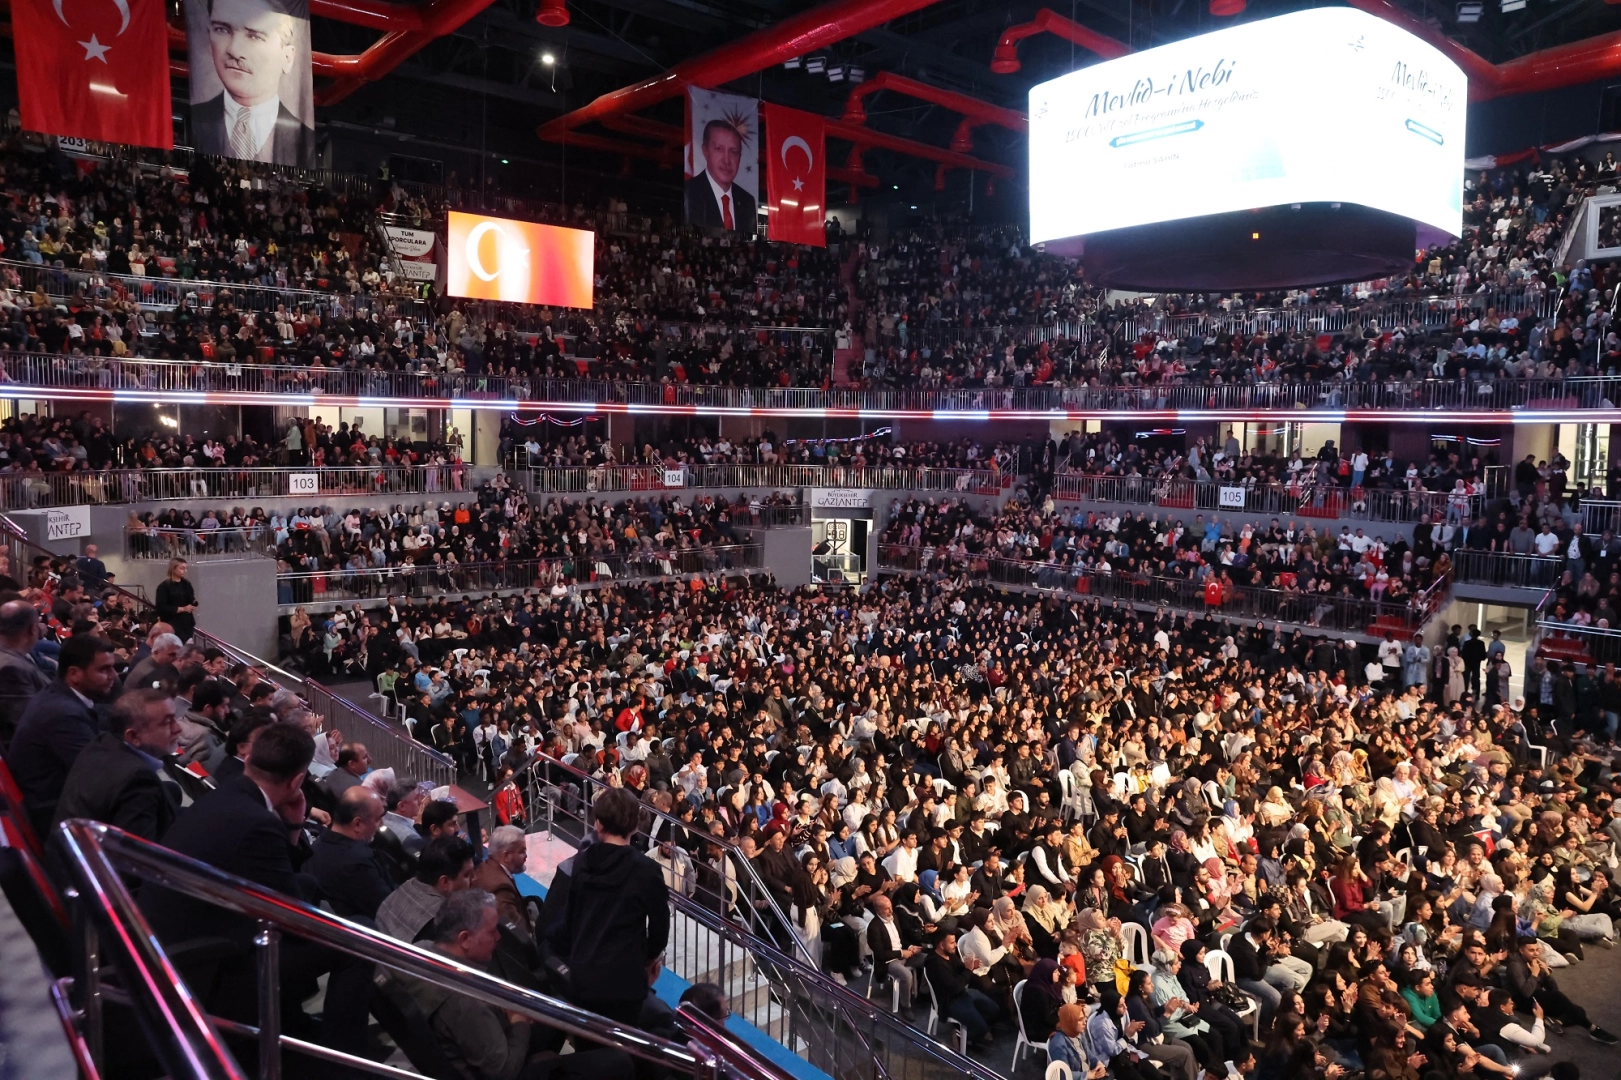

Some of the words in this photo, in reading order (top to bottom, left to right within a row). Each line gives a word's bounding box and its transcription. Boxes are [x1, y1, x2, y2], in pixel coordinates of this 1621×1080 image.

[1085, 74, 1177, 119] Mevlid-i
[1179, 58, 1236, 95] Nebi
[60, 135, 84, 147] 203
[389, 236, 427, 246] PORCULARA
[293, 478, 314, 489] 103
[667, 474, 681, 483] 104
[1223, 491, 1242, 502] 105
